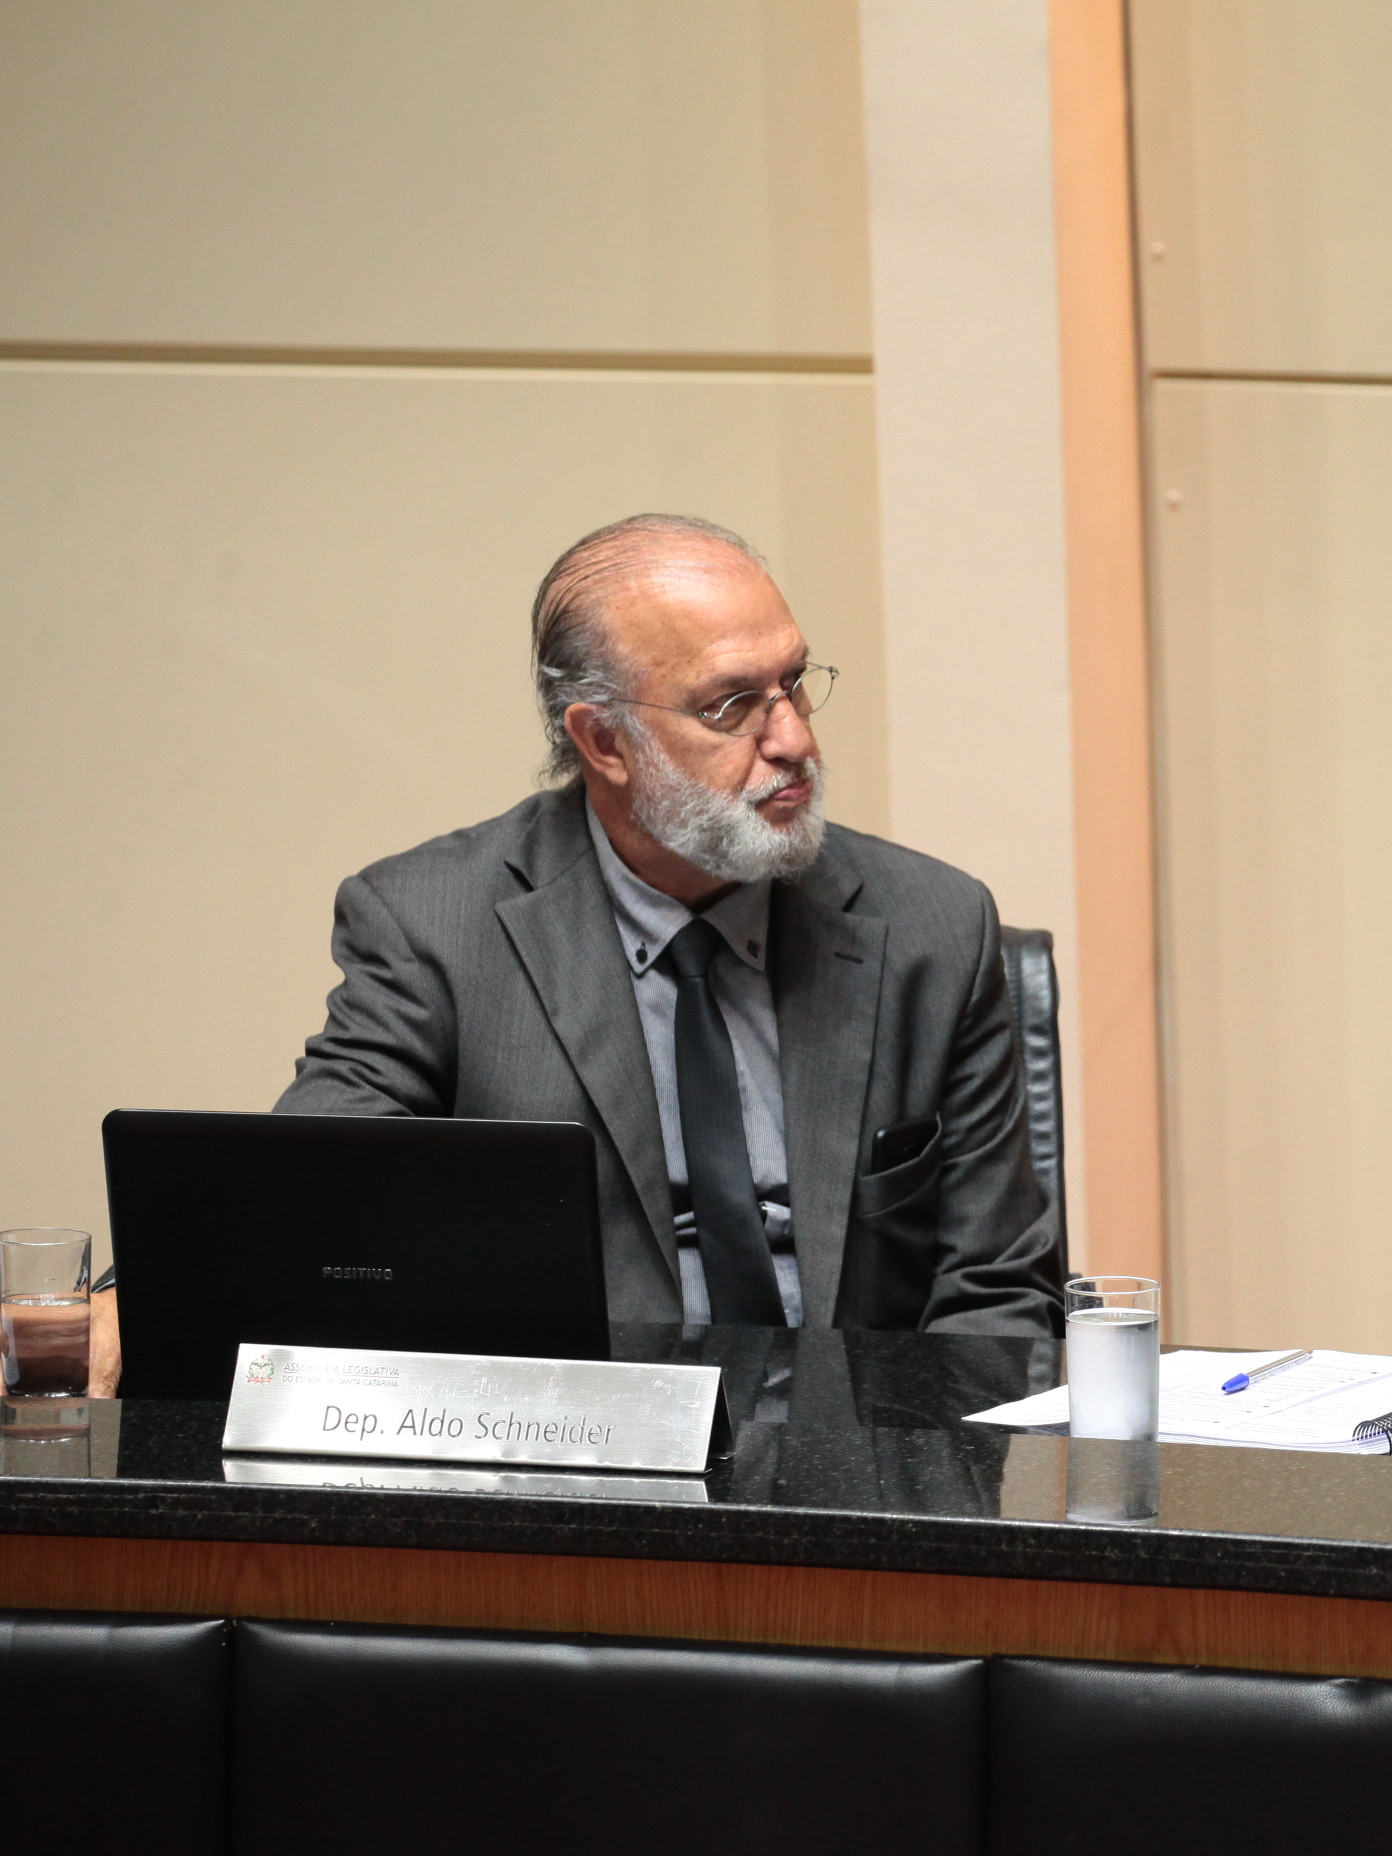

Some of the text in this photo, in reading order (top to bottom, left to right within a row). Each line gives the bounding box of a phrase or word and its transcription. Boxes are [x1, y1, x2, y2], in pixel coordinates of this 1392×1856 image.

[322, 1266, 393, 1281] POSITIVO
[342, 1364, 400, 1376] LEGISLATIVA
[281, 1374, 294, 1383] DO
[362, 1379, 399, 1388] CATARINA
[322, 1405, 616, 1445] Dep. Aldo Schneider
